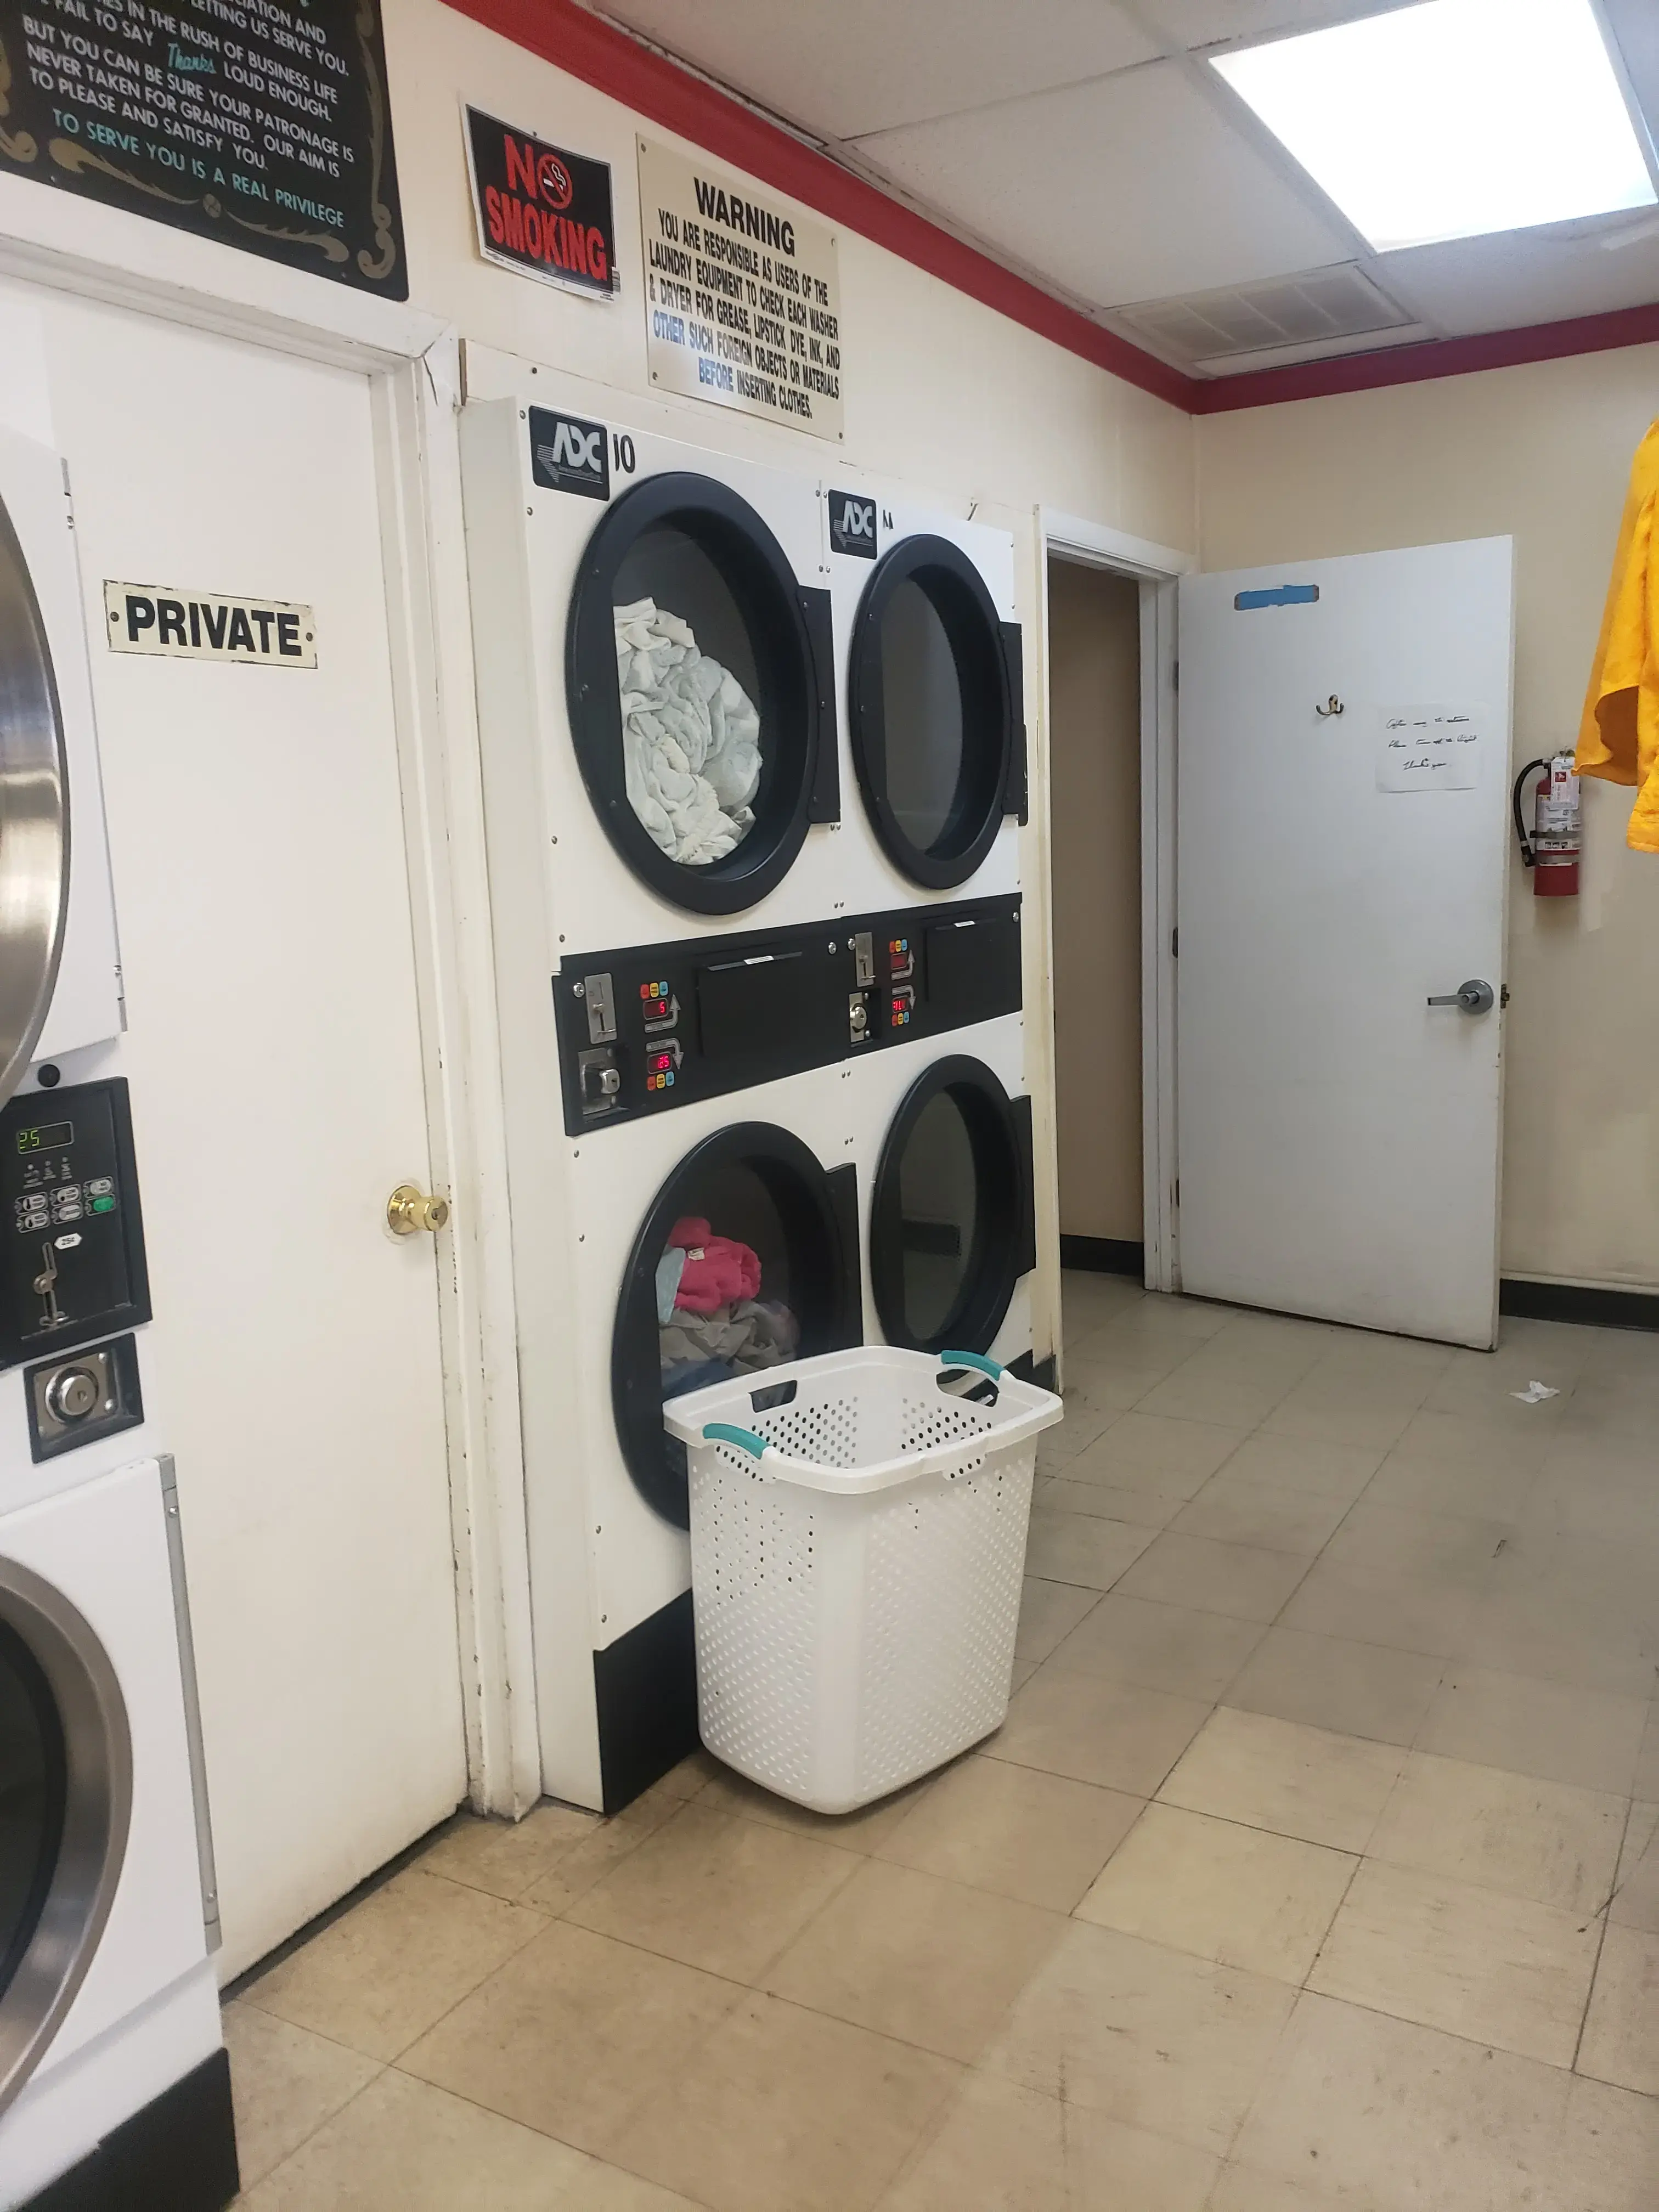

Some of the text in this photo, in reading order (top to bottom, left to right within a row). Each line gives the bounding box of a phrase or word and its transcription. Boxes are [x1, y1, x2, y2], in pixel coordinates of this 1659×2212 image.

[94, 8, 117, 31] TO
[121, 20, 154, 47] SAY
[168, 43, 217, 74] Thanks
[224, 60, 264, 92] LOUD
[268, 80, 332, 122] ENOUGH.
[128, 0, 145, 21] IN
[148, 8, 177, 35] THE
[180, 21, 219, 52] RUSH
[224, 41, 244, 61] OF
[247, 50, 310, 92] BUSINESS
[314, 80, 337, 104] LIFE
[250, 17, 269, 39] US
[273, 27, 312, 59] SERVE
[316, 48, 349, 76] YOU.
[295, 19, 326, 44] AND
[22, 14, 354, 163] BUT YOU CAN BE SURE YOUR PATRONAGE IS
[27, 40, 340, 178] NEVER TAKEN FOR GRANTED. OUR AIM IS
[30, 65, 269, 171] TO PLEASE AND SATISFY YOU.
[52, 108, 345, 228] TO SERVE YOU IS A REAL PRIVILEGE
[504, 134, 572, 210] NO
[486, 185, 607, 281] SMOKING
[658, 208, 828, 307] YOU ARE RESPONSIBLE AS USERS OF THE
[693, 177, 795, 257] WARNING
[649, 238, 839, 341] LAUNDRY EQUIPMENT TO CHECK EACH WASHER
[650, 273, 840, 370] & DRYER FOR GREASE, LIPSTICK DYE, INK, AND
[653, 309, 840, 400] OTHER SUCH FOREIGN OBJECTS OR MATERIALS
[698, 357, 733, 392] BEFORE
[737, 369, 777, 407] INSERTING
[552, 421, 602, 473] ADC
[613, 433, 635, 473] 10
[842, 500, 873, 538] ADC
[126, 595, 302, 656] PRIVATE
[659, 1001, 665, 1013] 5
[20, 1130, 40, 1149] 25
